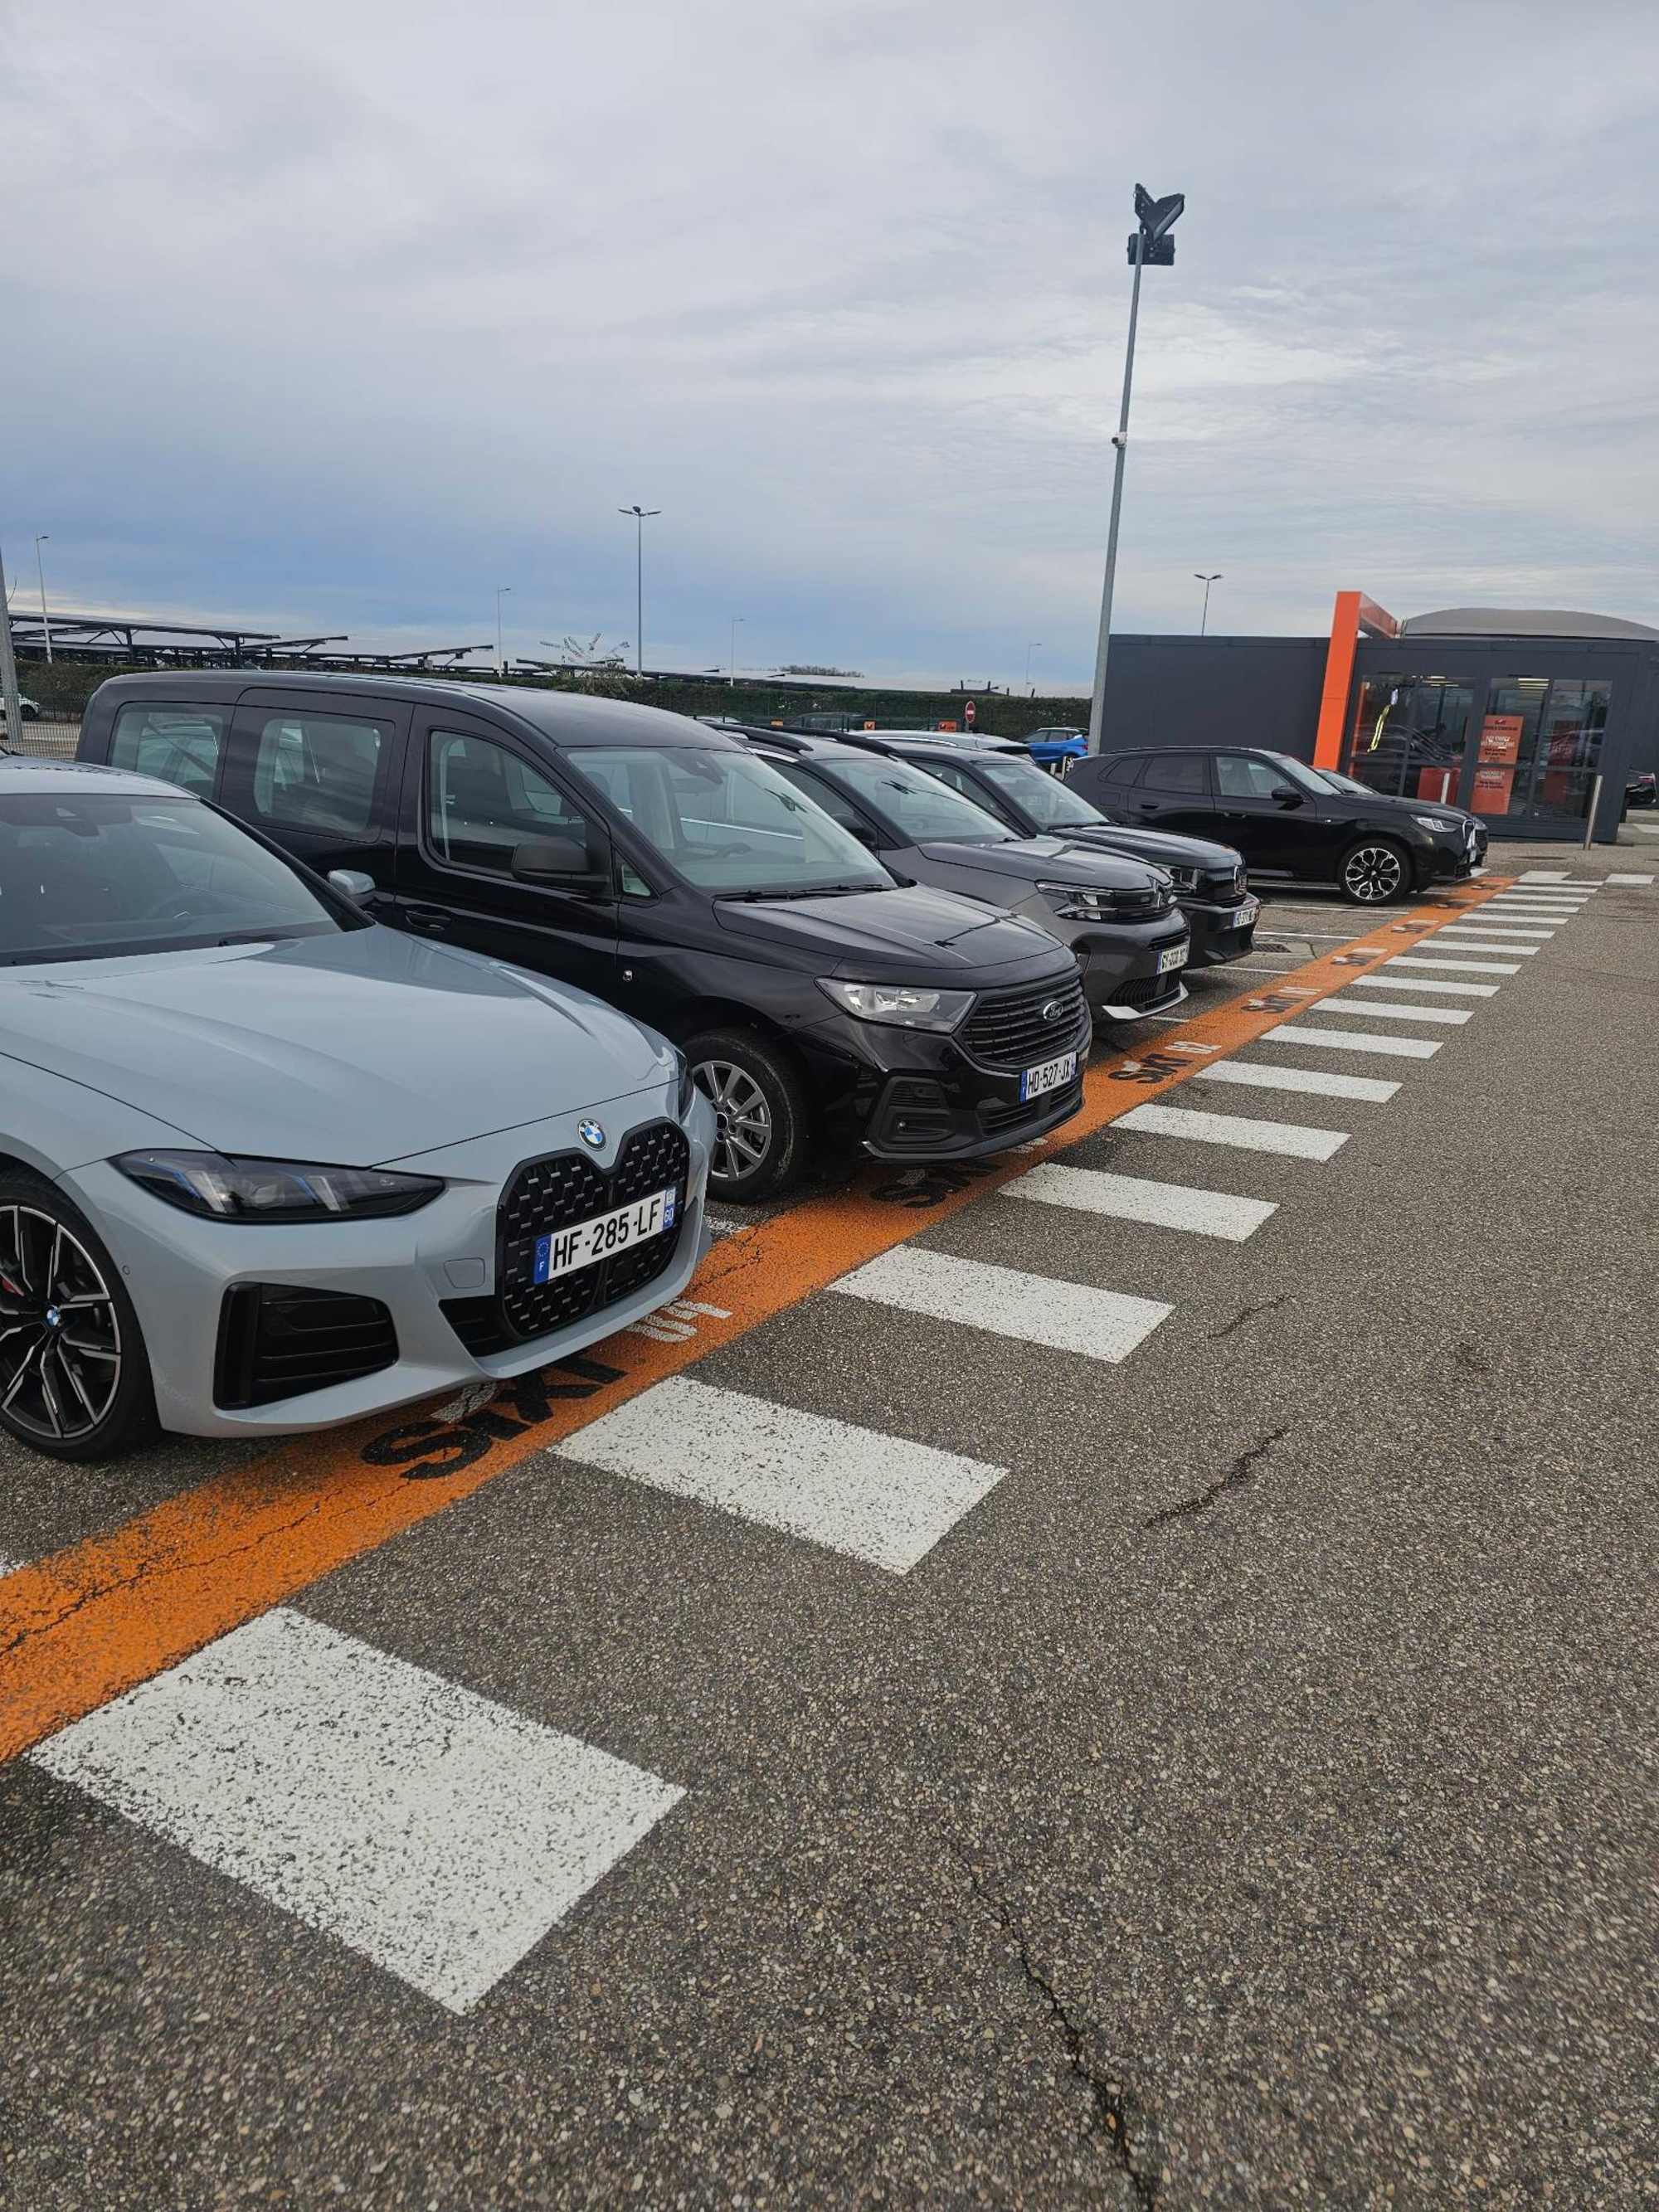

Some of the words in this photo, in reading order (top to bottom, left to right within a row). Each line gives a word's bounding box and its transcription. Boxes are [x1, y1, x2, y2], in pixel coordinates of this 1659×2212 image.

[1028, 1059, 1070, 1094] HD-527-JX
[553, 1198, 661, 1271] HF-285-LF
[538, 1261, 545, 1271] F
